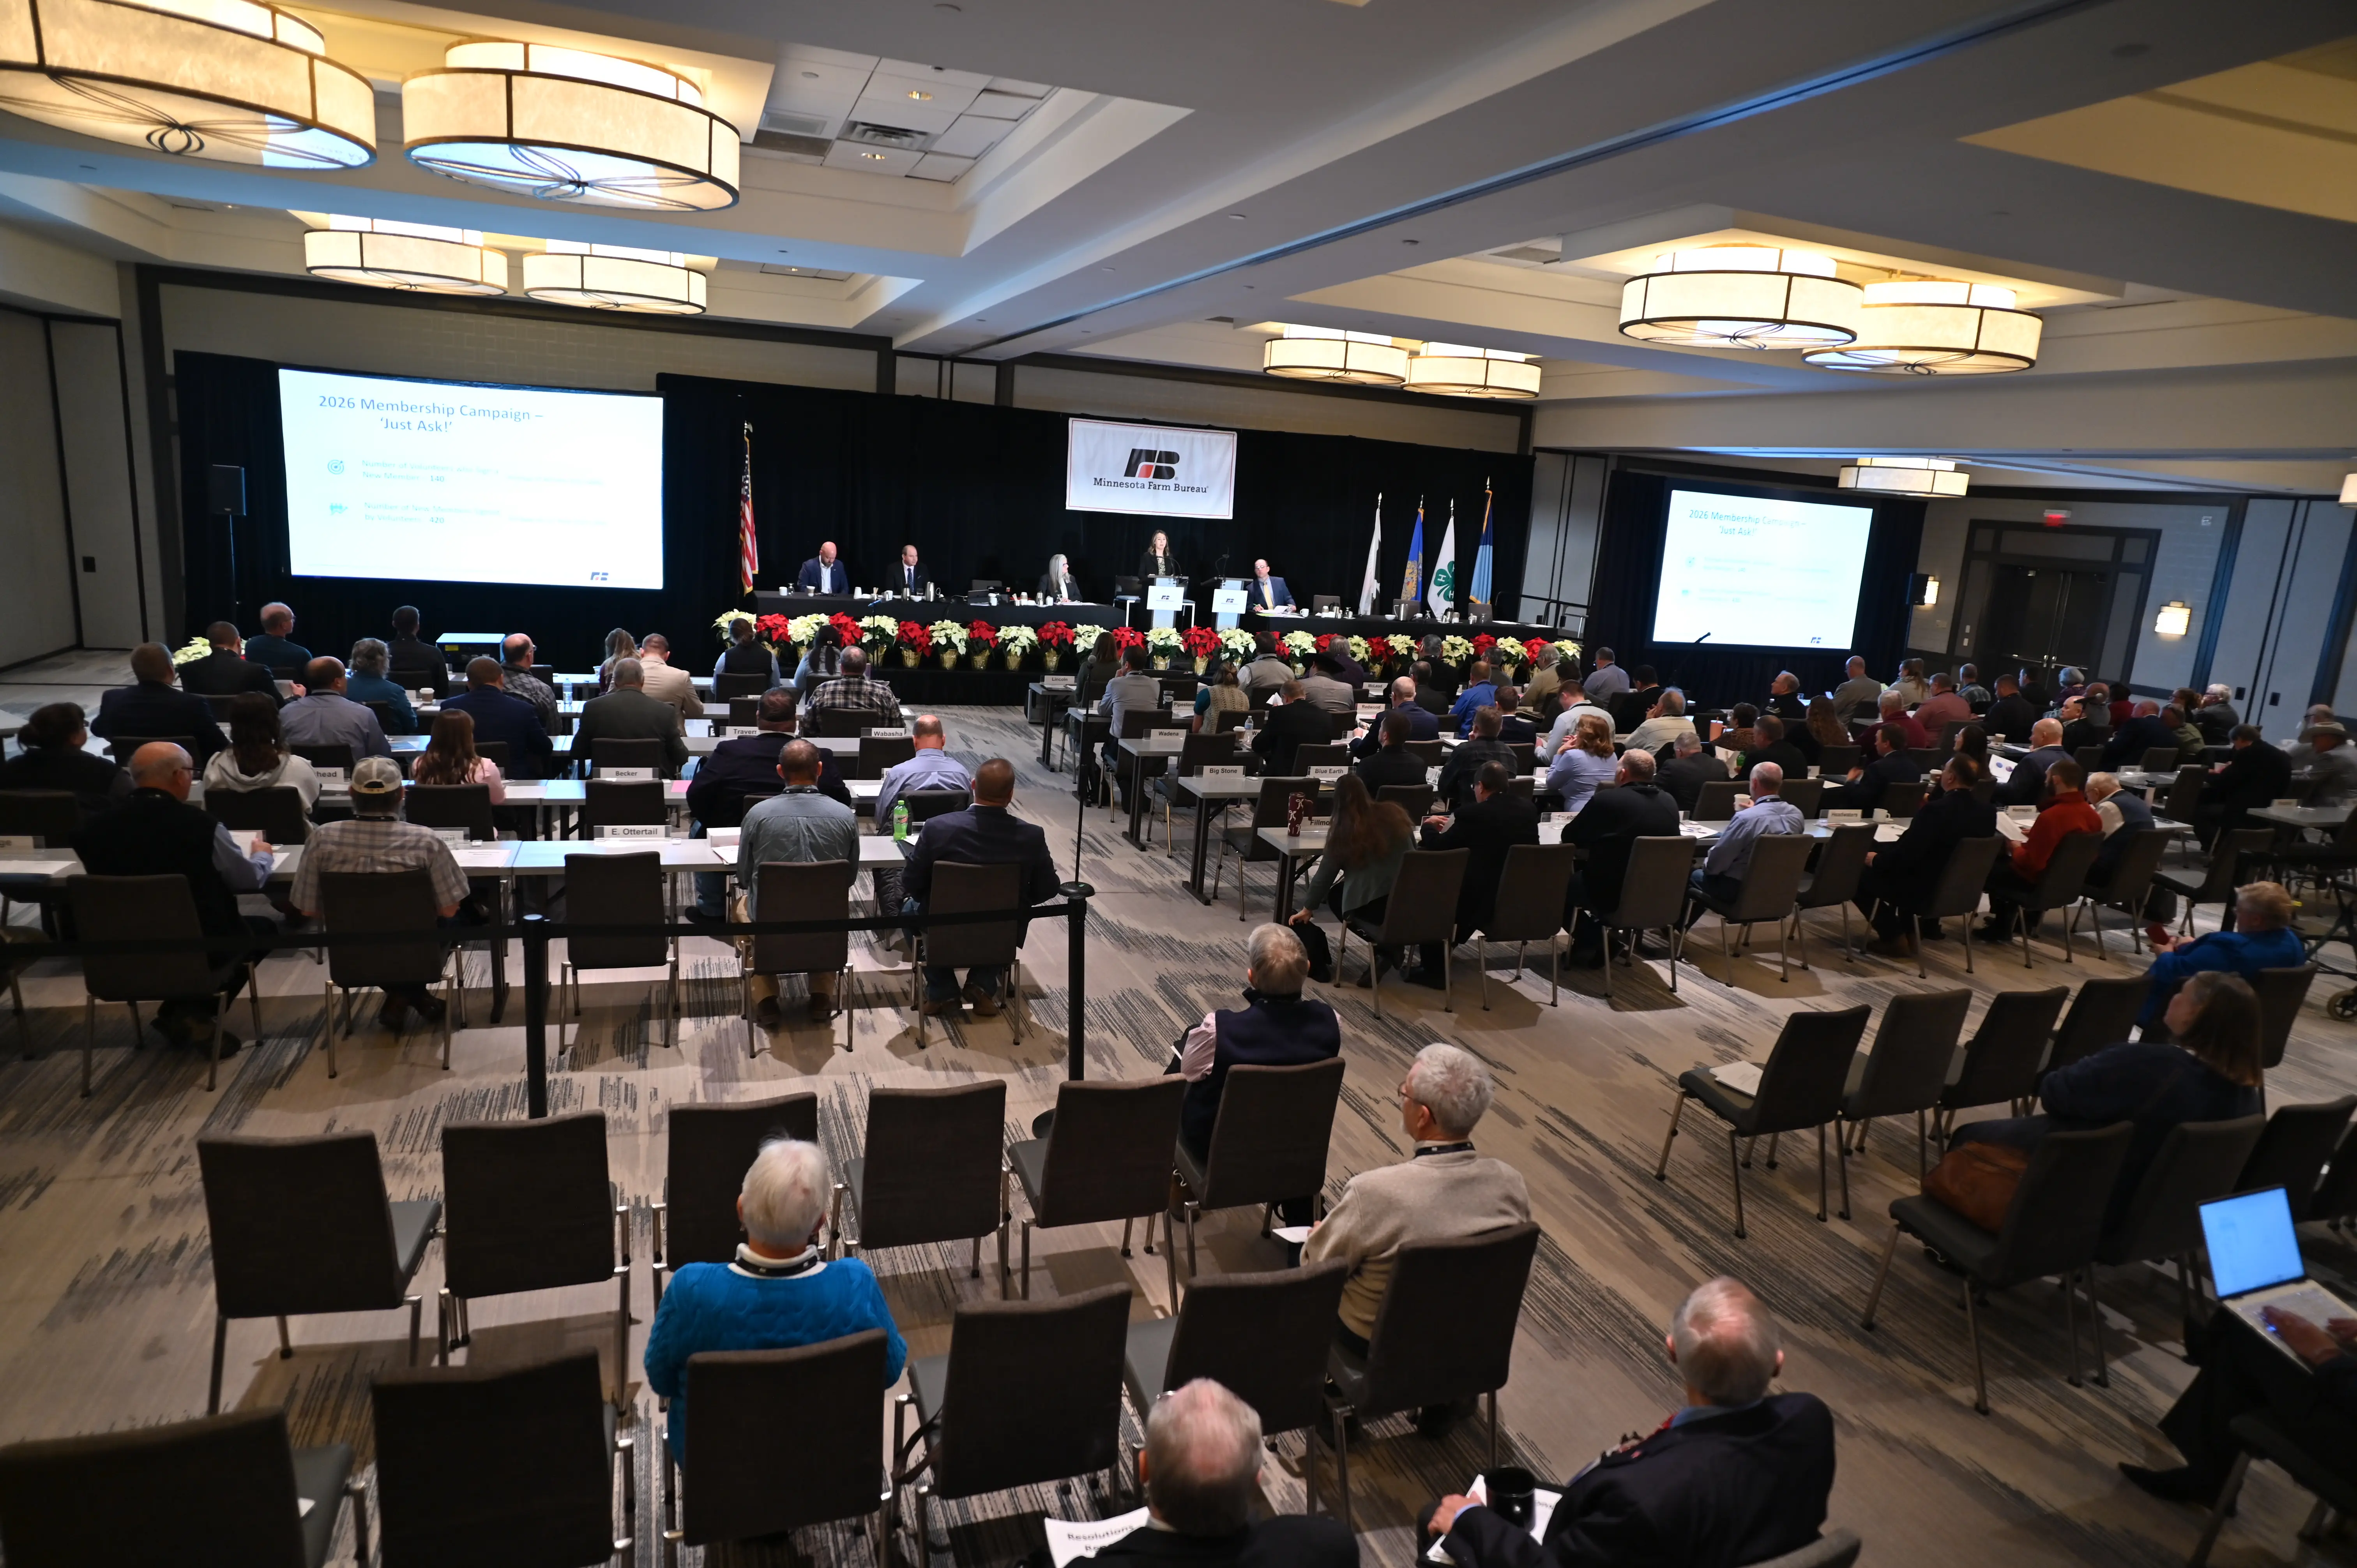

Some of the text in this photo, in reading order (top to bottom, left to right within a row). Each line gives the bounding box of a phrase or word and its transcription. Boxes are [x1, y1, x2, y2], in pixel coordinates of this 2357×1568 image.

[319, 396, 355, 408] 2026
[361, 399, 454, 417] Membership
[460, 405, 530, 422] Campaign
[1094, 477, 1207, 493] Minnesota Farm Bureau
[1689, 510, 1709, 519] 2026
[1711, 512, 1760, 525] Membership
[1067, 1525, 1134, 1541] Resolutions
